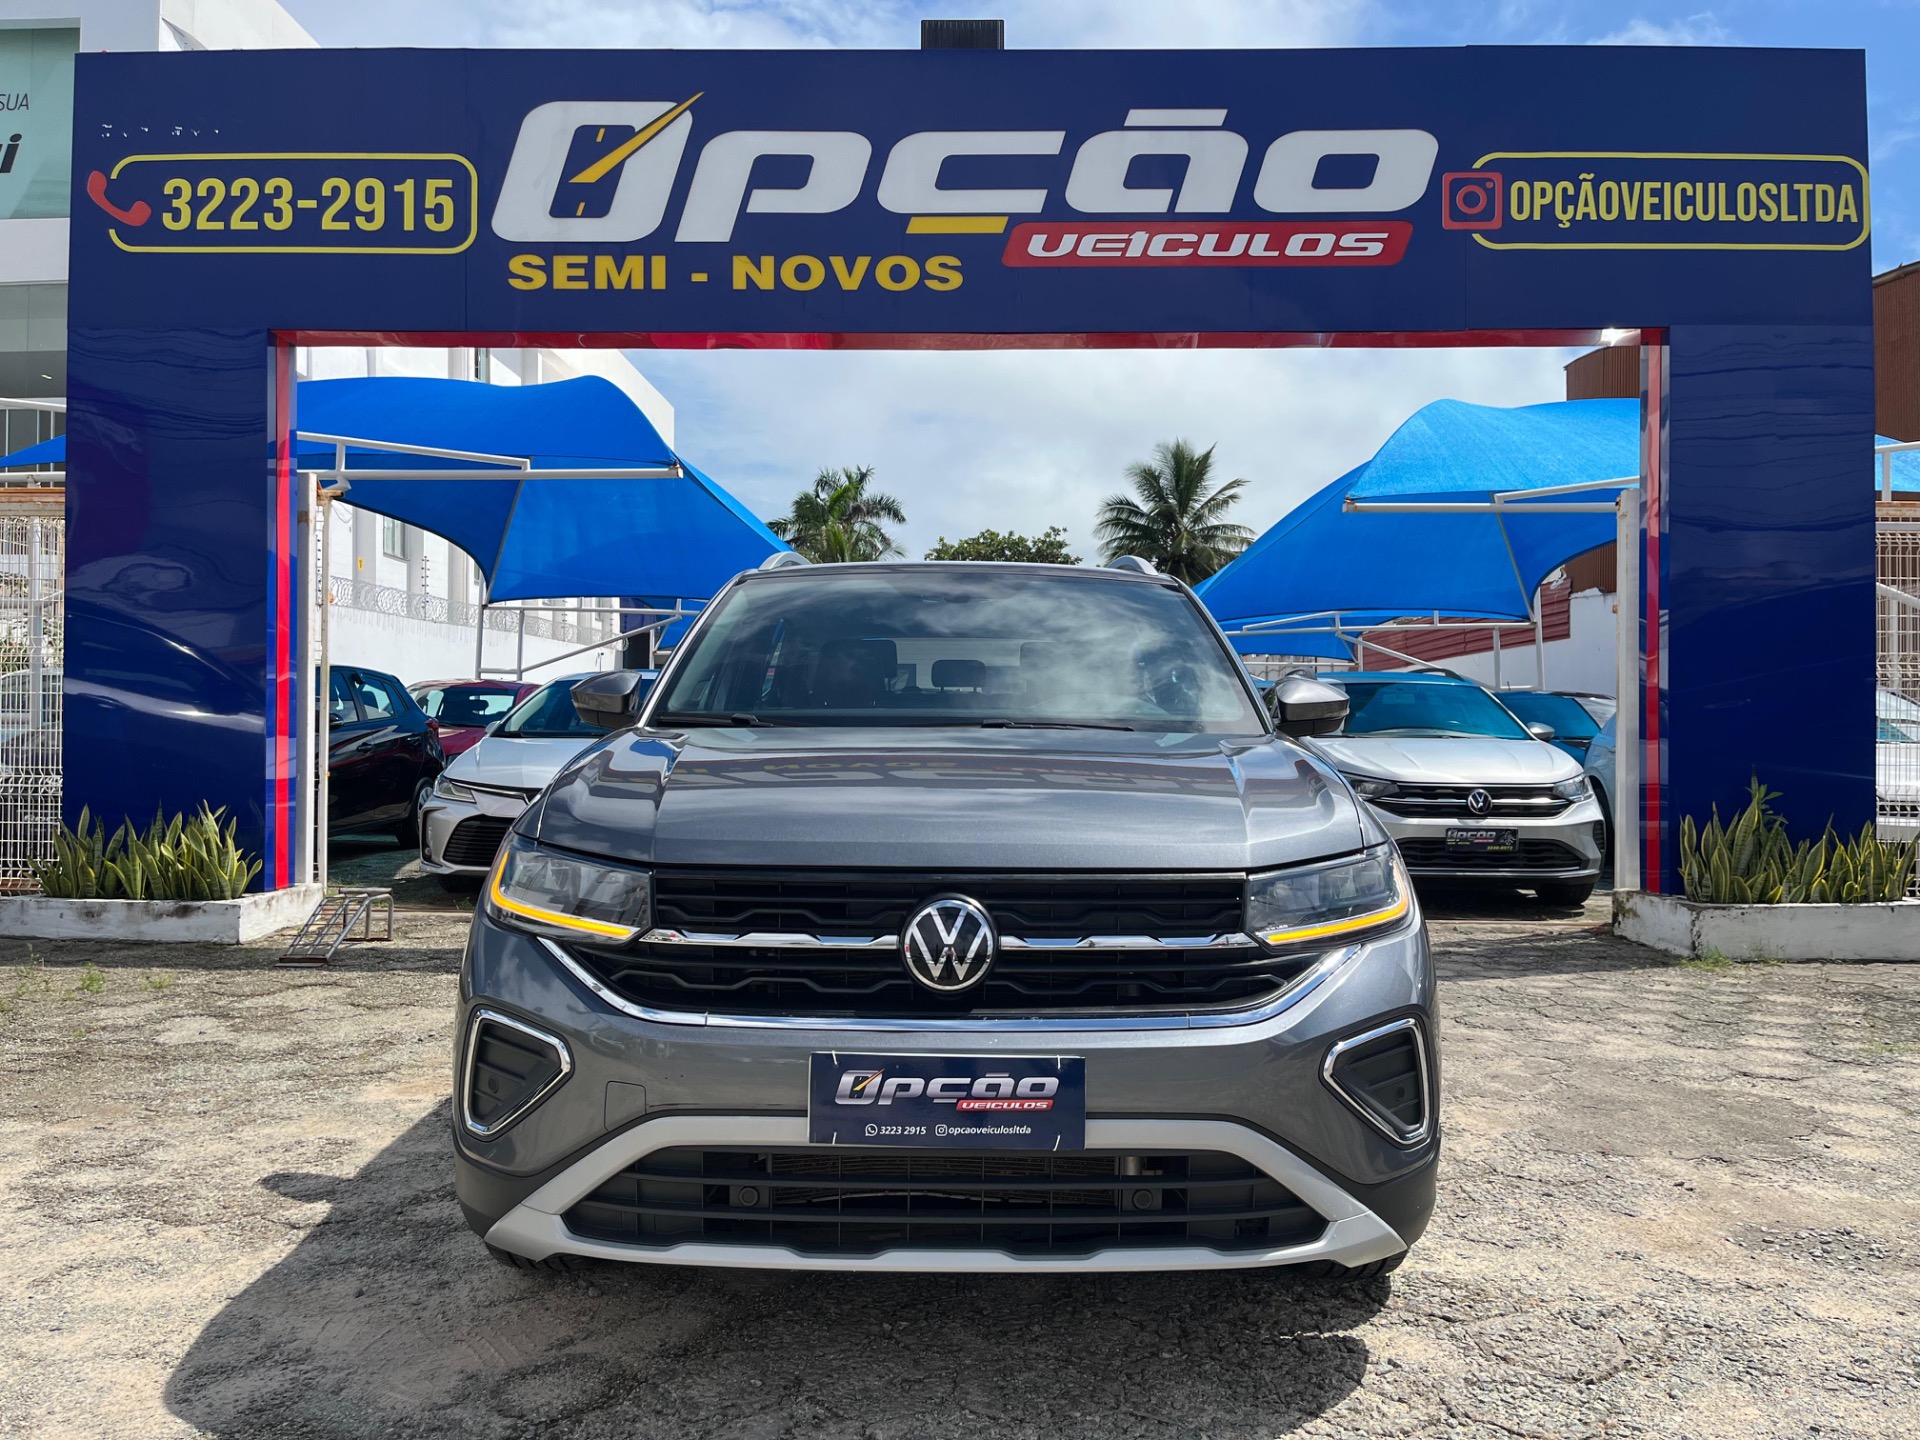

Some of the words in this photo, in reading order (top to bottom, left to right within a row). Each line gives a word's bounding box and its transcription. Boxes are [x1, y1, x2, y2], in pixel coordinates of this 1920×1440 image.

[162, 178, 455, 232] 3223-2915
[1510, 173, 1858, 228] OPÇÃOVEICULOSLTDA
[507, 254, 666, 291] SEMI
[732, 254, 964, 291] NOVOS
[880, 1125, 901, 1135] 3223
[904, 1125, 927, 1135] 2915
[949, 1124, 1032, 1138] opcaoveiculosltda
